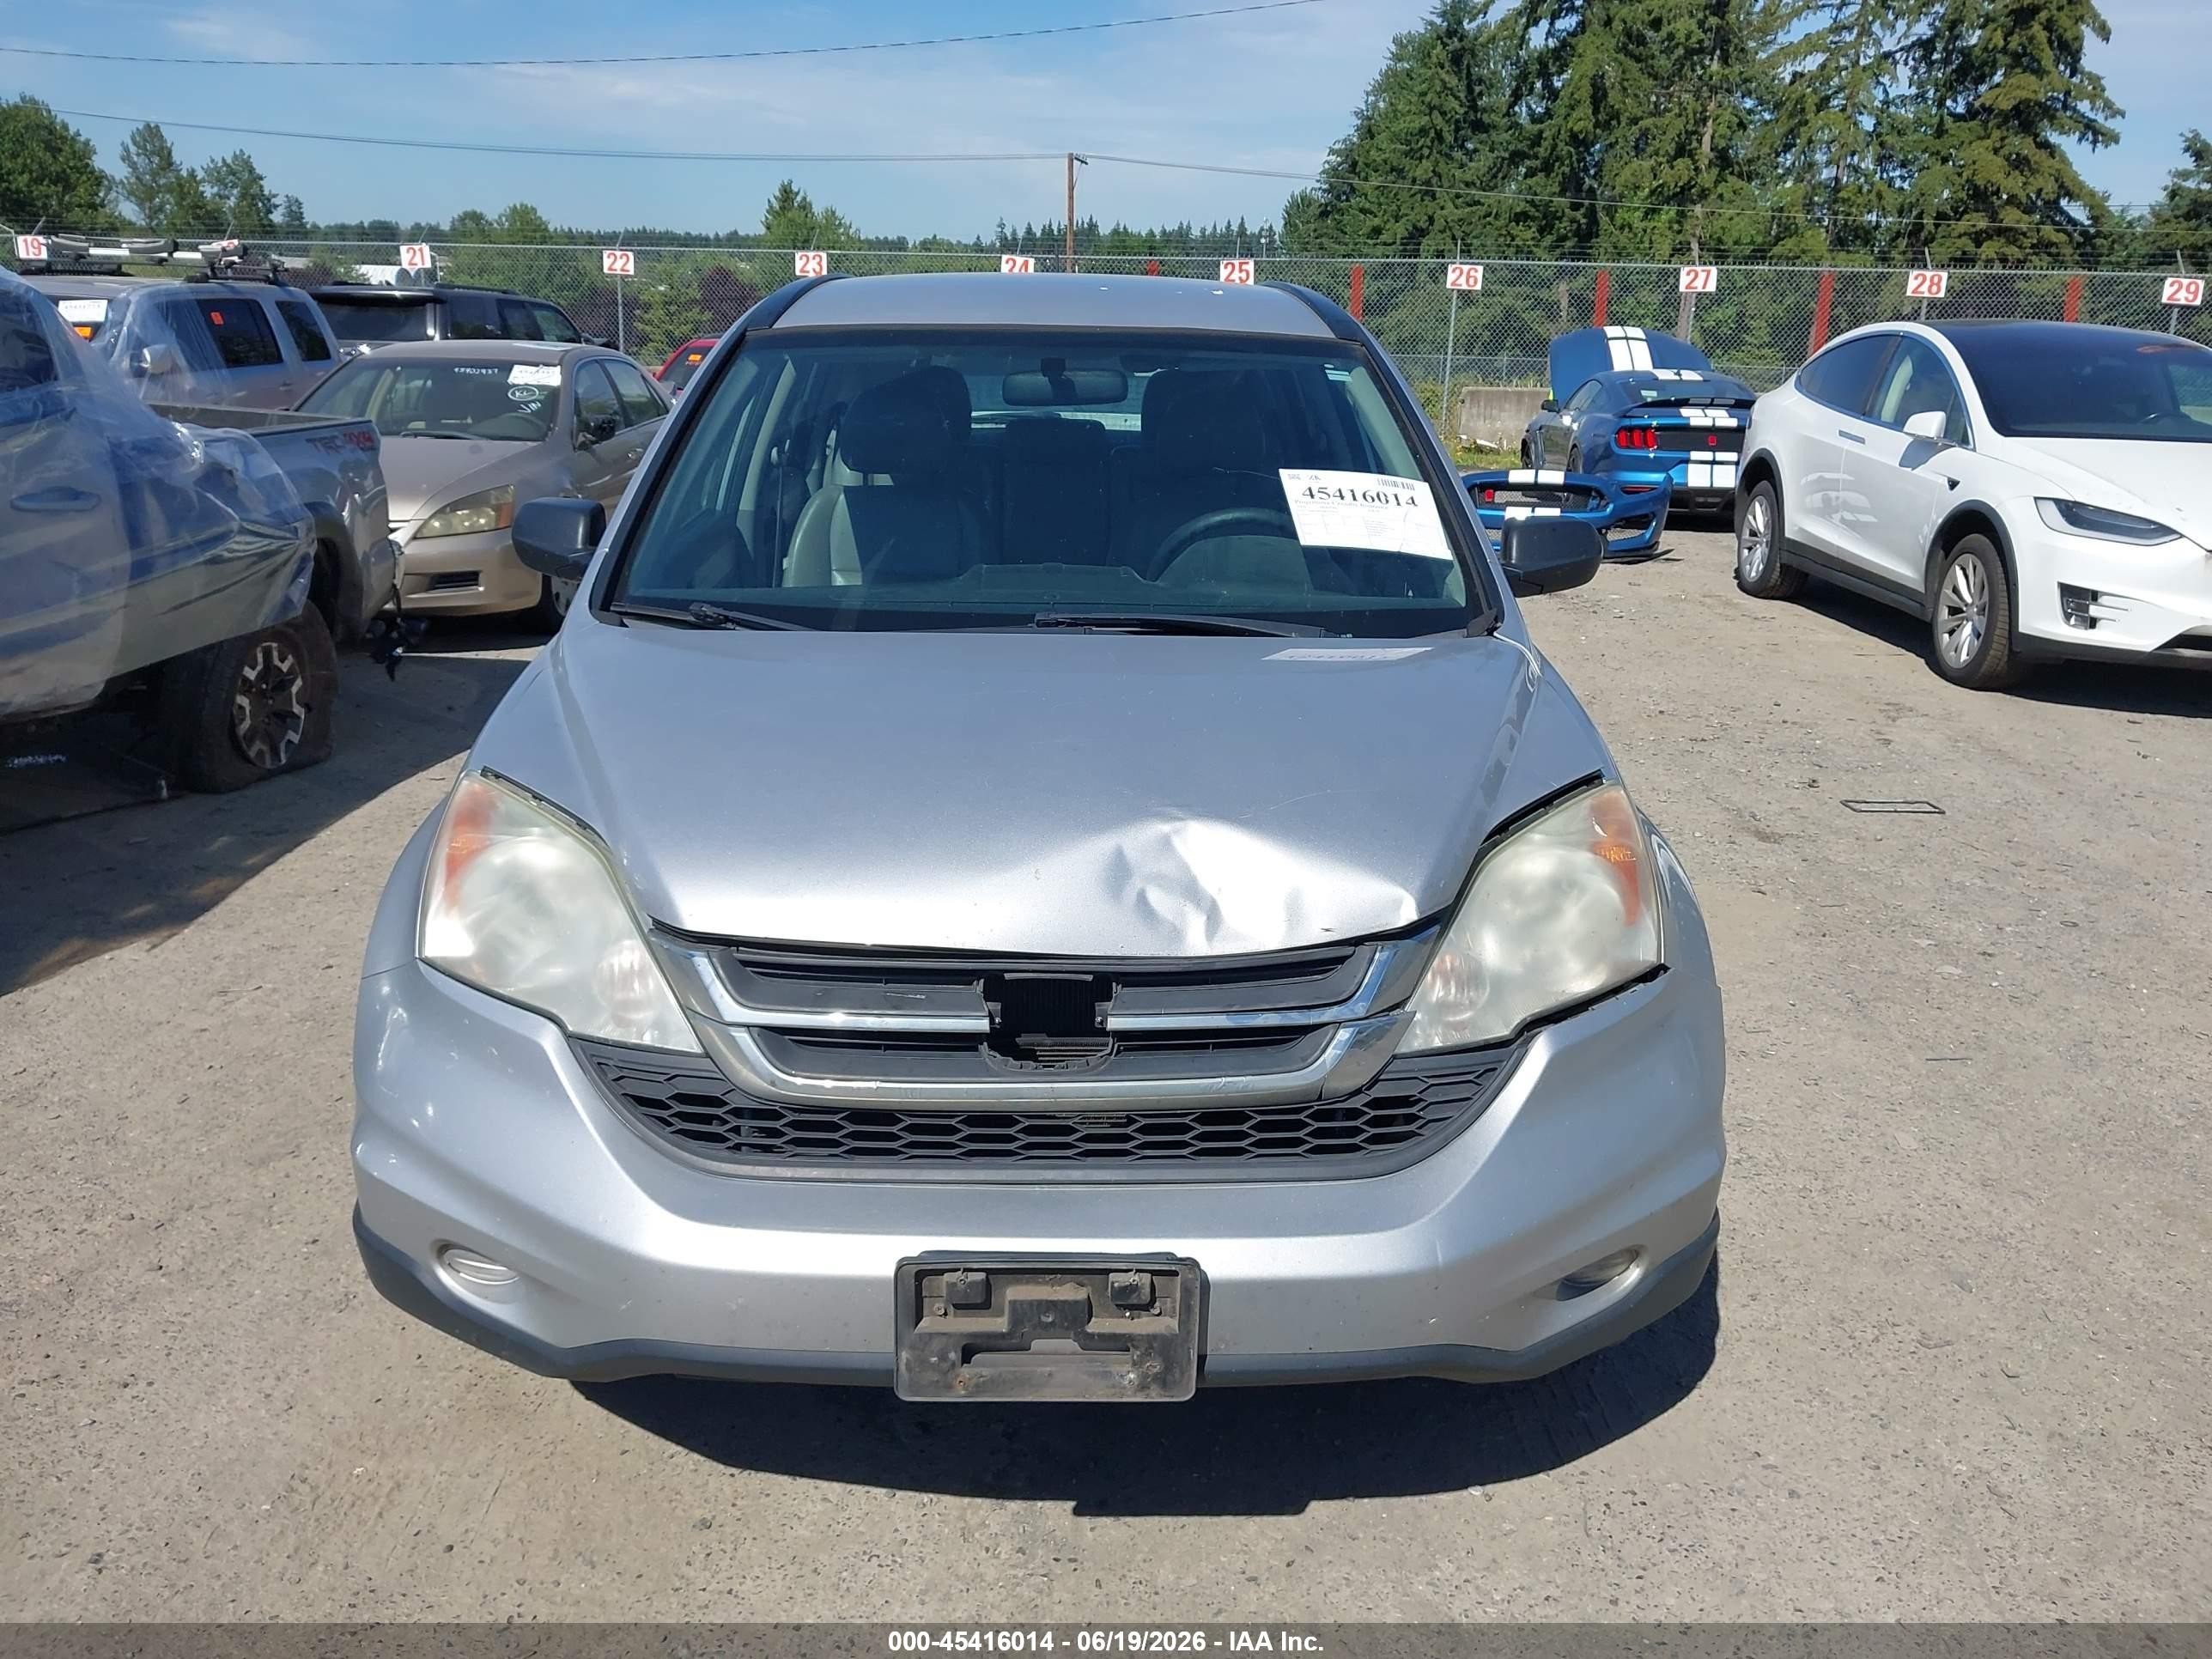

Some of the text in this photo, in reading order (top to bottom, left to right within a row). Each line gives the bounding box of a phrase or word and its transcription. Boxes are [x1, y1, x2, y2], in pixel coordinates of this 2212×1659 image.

[22, 237, 42, 257] 19
[407, 247, 426, 266] 21
[606, 252, 631, 274] 22
[799, 253, 823, 276] 23
[1224, 261, 1250, 283] 25
[1450, 266, 1479, 289] 26
[1684, 269, 1712, 290] 27
[1911, 273, 1942, 296] 28
[2166, 279, 2200, 303] 29
[1302, 485, 1419, 507] 45416014
